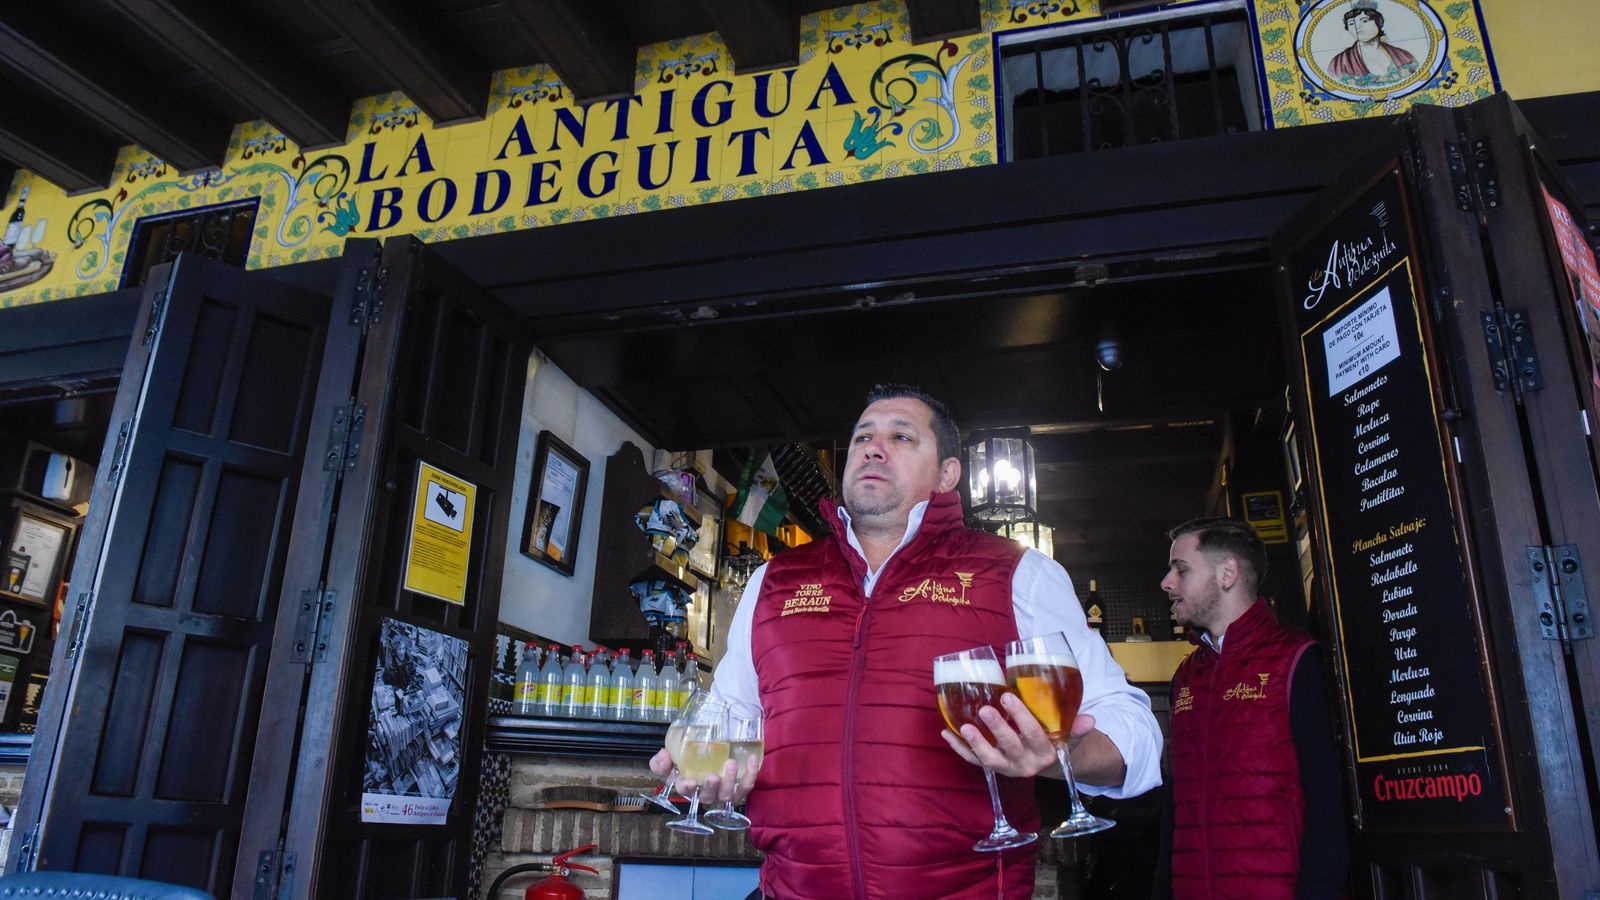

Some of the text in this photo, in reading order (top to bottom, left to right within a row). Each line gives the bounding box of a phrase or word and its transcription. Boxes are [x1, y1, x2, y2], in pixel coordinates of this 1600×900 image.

[354, 61, 857, 184] LA ANTIGUA
[364, 119, 831, 232] BODEGUITA
[1304, 236, 1373, 309] Antigua
[1328, 304, 1387, 349] DE PAGO CON TARJETA
[1335, 302, 1378, 336] IMPORTE MÍNIMO
[1354, 331, 1364, 342] 10€
[1335, 340, 1390, 380] PAYMENT WITH CARD
[1339, 335, 1385, 369] MINIMUM AMOUNT
[1344, 375, 1388, 407] Salmonetes
[1357, 399, 1380, 418] Rape
[1353, 413, 1390, 439] Merluza
[1358, 432, 1390, 455] Corvina
[1355, 448, 1399, 475] Calamares
[1362, 468, 1398, 492] Bacalao
[1360, 485, 1405, 512] Puntillitas
[1352, 518, 1426, 554] Plancha Salvaje:
[1369, 542, 1414, 567] Salmonete
[1371, 560, 1418, 587] Rodaballo
[783, 595, 832, 610] BERAUN
[795, 589, 823, 597] TORRE
[1382, 585, 1413, 604] Lubina
[1383, 602, 1418, 623] Dorada
[1389, 627, 1417, 642] Pargo
[1394, 647, 1417, 661] Urta
[1389, 666, 1430, 684] Merluza
[1390, 684, 1436, 705] Lenguado
[1397, 709, 1433, 724] Corvina
[1393, 728, 1444, 746] Atún Rojo
[1374, 772, 1482, 801] Cruzcampo
[402, 803, 414, 816] 46
